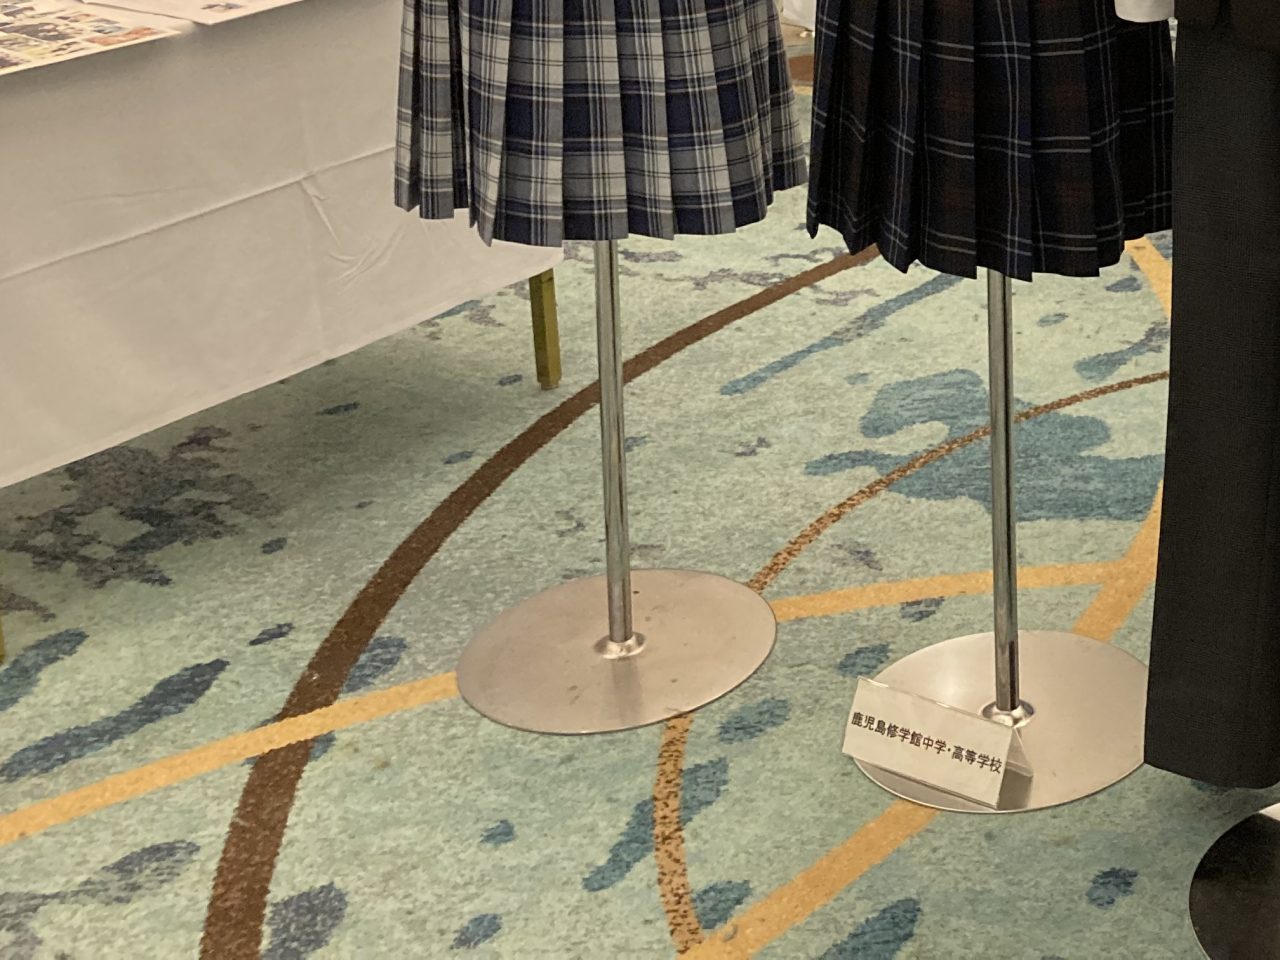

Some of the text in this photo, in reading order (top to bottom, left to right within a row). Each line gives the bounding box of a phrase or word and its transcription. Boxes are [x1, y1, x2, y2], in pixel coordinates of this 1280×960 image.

[851, 711, 1003, 774] 鹿児島修学館中学・高等学校
